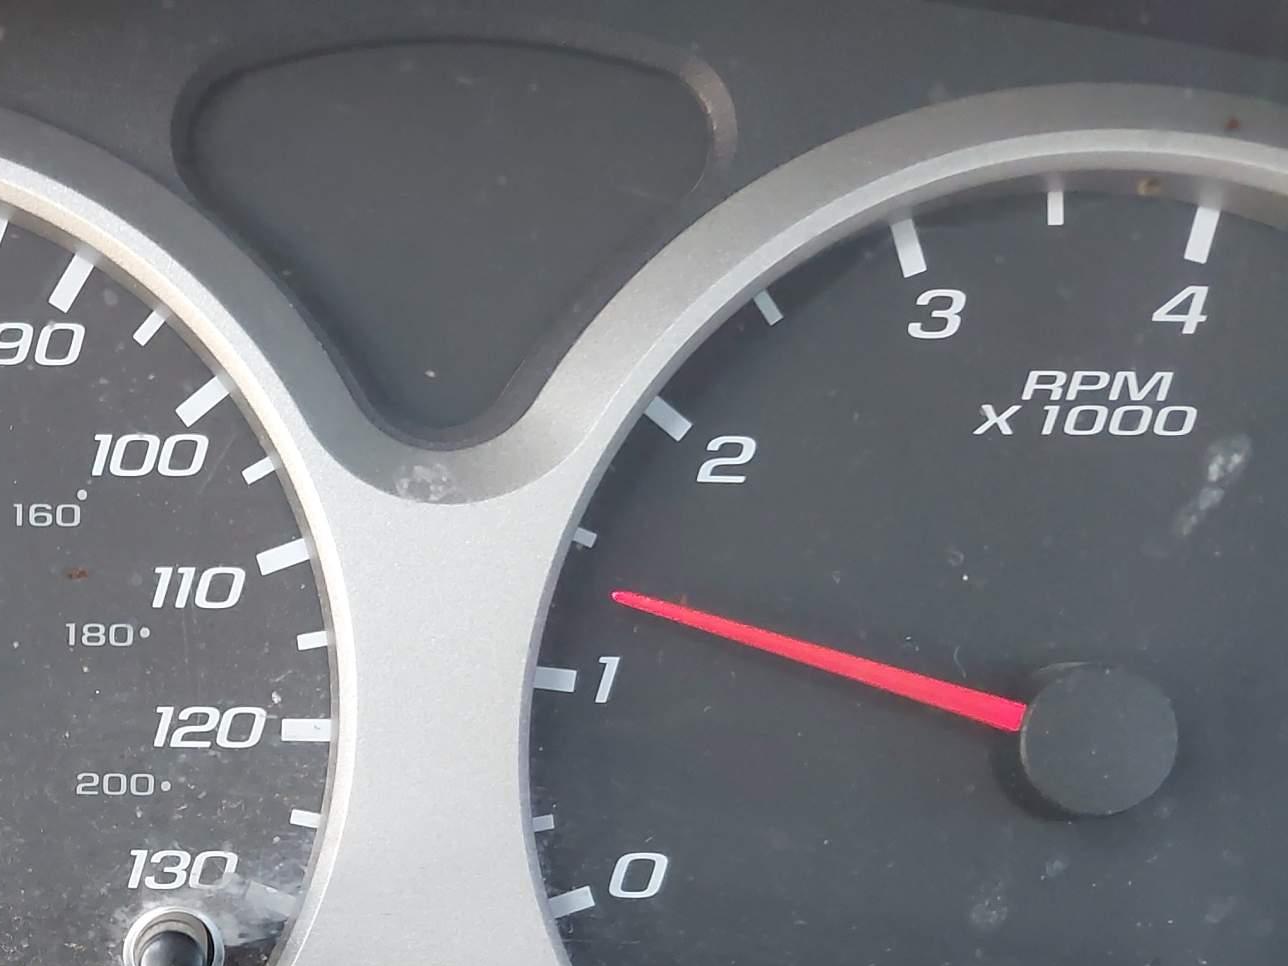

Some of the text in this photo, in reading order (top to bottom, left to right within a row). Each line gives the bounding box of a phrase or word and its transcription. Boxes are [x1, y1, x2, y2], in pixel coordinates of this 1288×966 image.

[907, 289, 966, 339] 3
[1152, 285, 1209, 334] 4
[1020, 371, 1174, 402] RPM
[1040, 404, 1198, 436] 1000
[91, 433, 210, 477] 100
[696, 436, 757, 484] 2
[13, 503, 82, 527] 160
[151, 566, 246, 609] 110
[65, 623, 134, 646] 180
[594, 656, 621, 704] 1
[152, 706, 266, 749] 120
[75, 772, 155, 796] 200
[126, 849, 238, 889] 130
[609, 852, 668, 898] 0
